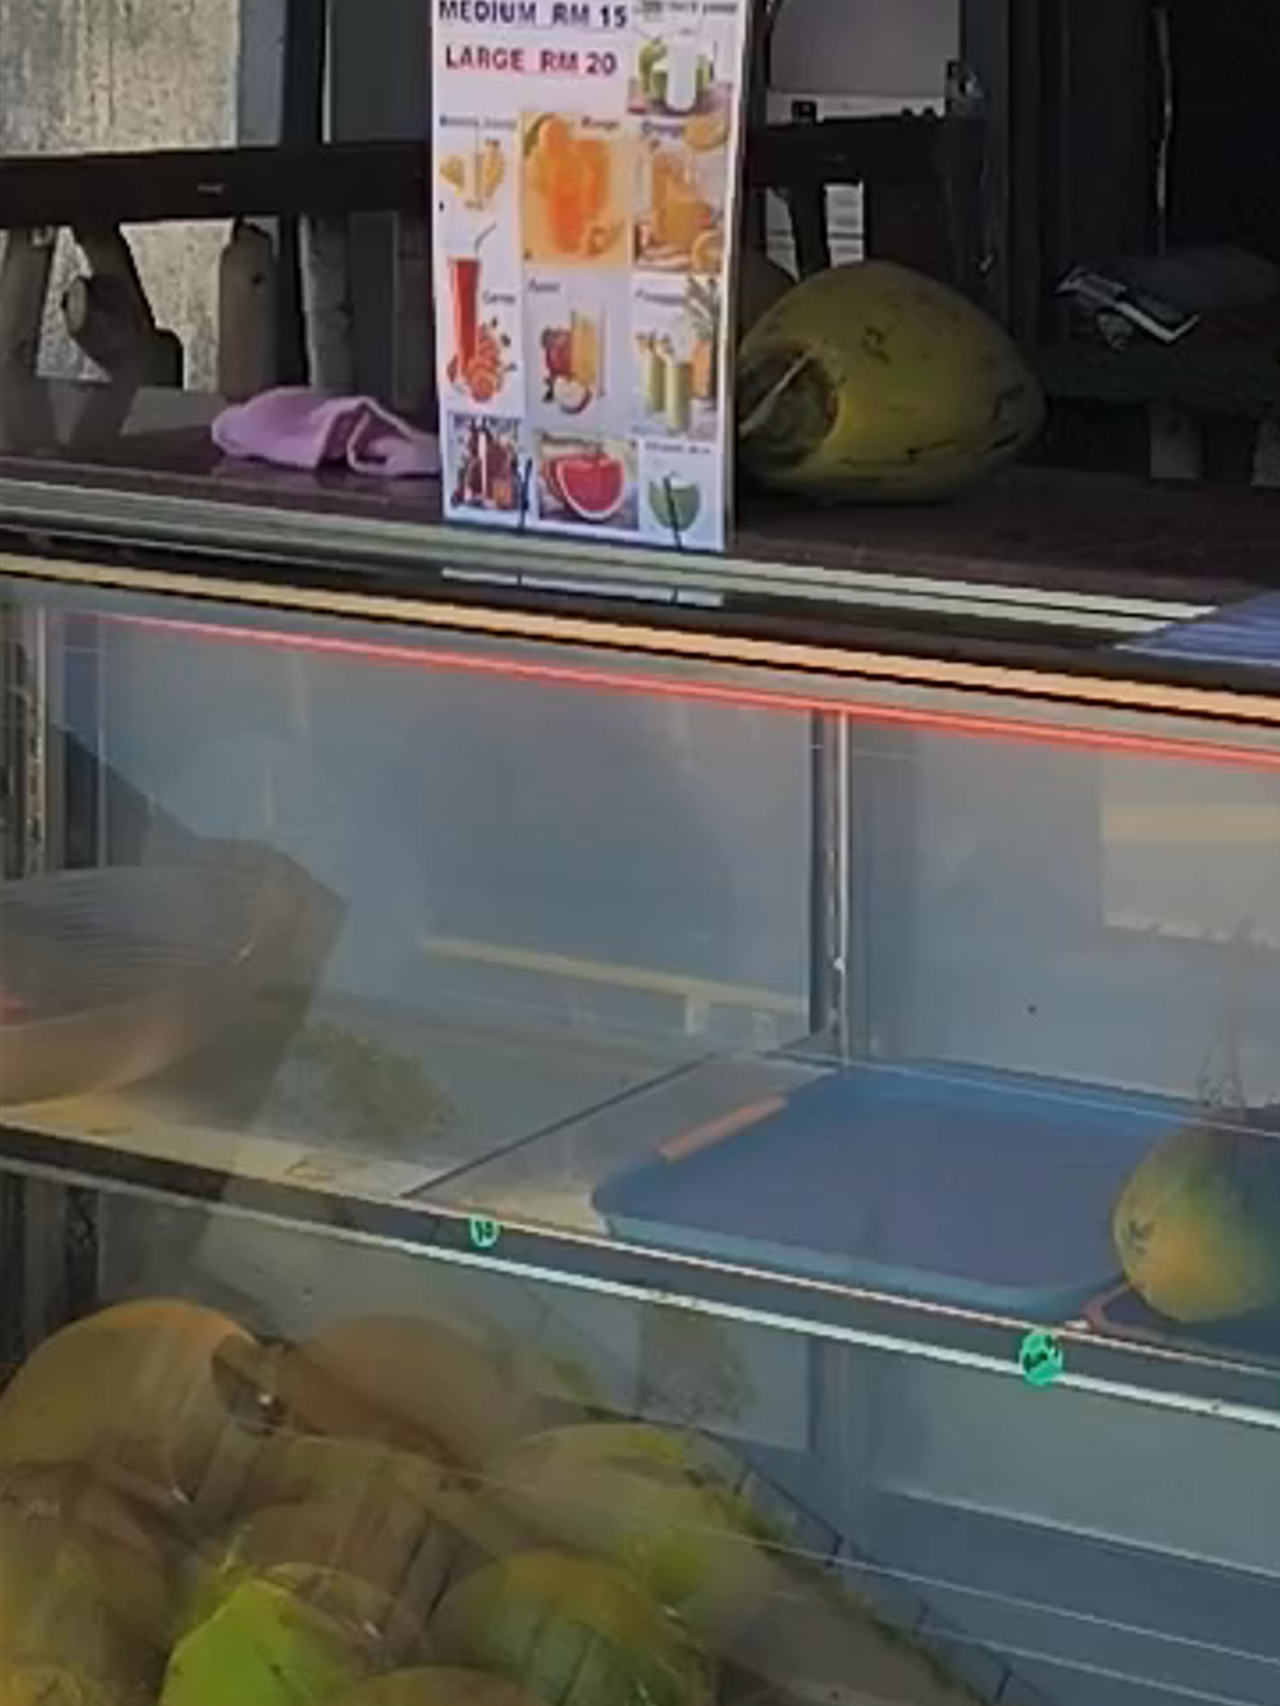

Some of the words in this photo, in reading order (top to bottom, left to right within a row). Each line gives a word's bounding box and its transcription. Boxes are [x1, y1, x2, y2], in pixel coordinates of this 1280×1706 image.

[552, 1, 590, 28] RM
[600, 5, 628, 29] 15
[445, 45, 524, 72] LARGE
[539, 49, 580, 74] RM
[586, 52, 618, 75] 20
